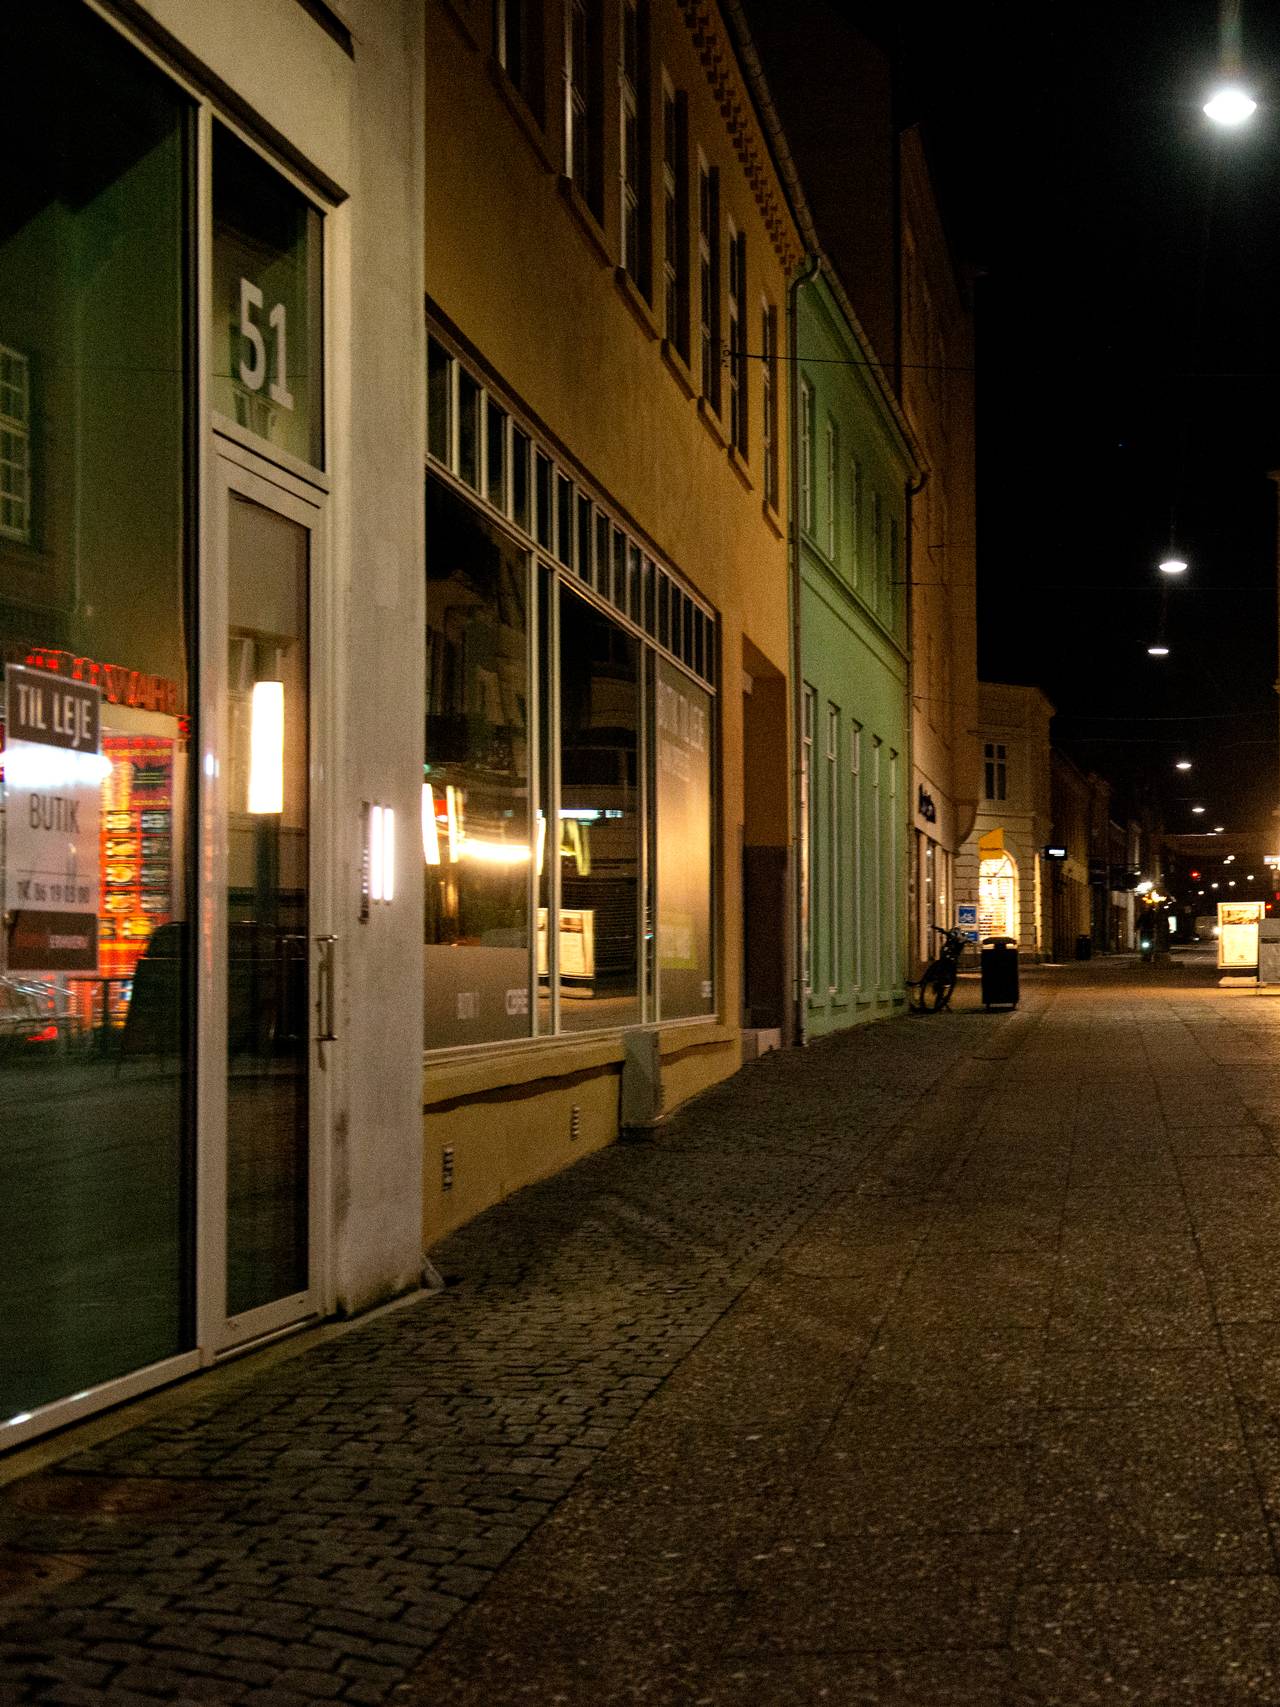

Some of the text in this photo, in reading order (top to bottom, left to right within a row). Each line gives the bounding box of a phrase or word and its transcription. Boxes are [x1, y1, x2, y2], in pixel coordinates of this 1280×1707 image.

[239, 277, 294, 411] 51
[17, 683, 92, 748] TIL LEJE
[30, 793, 80, 834] BUTIK
